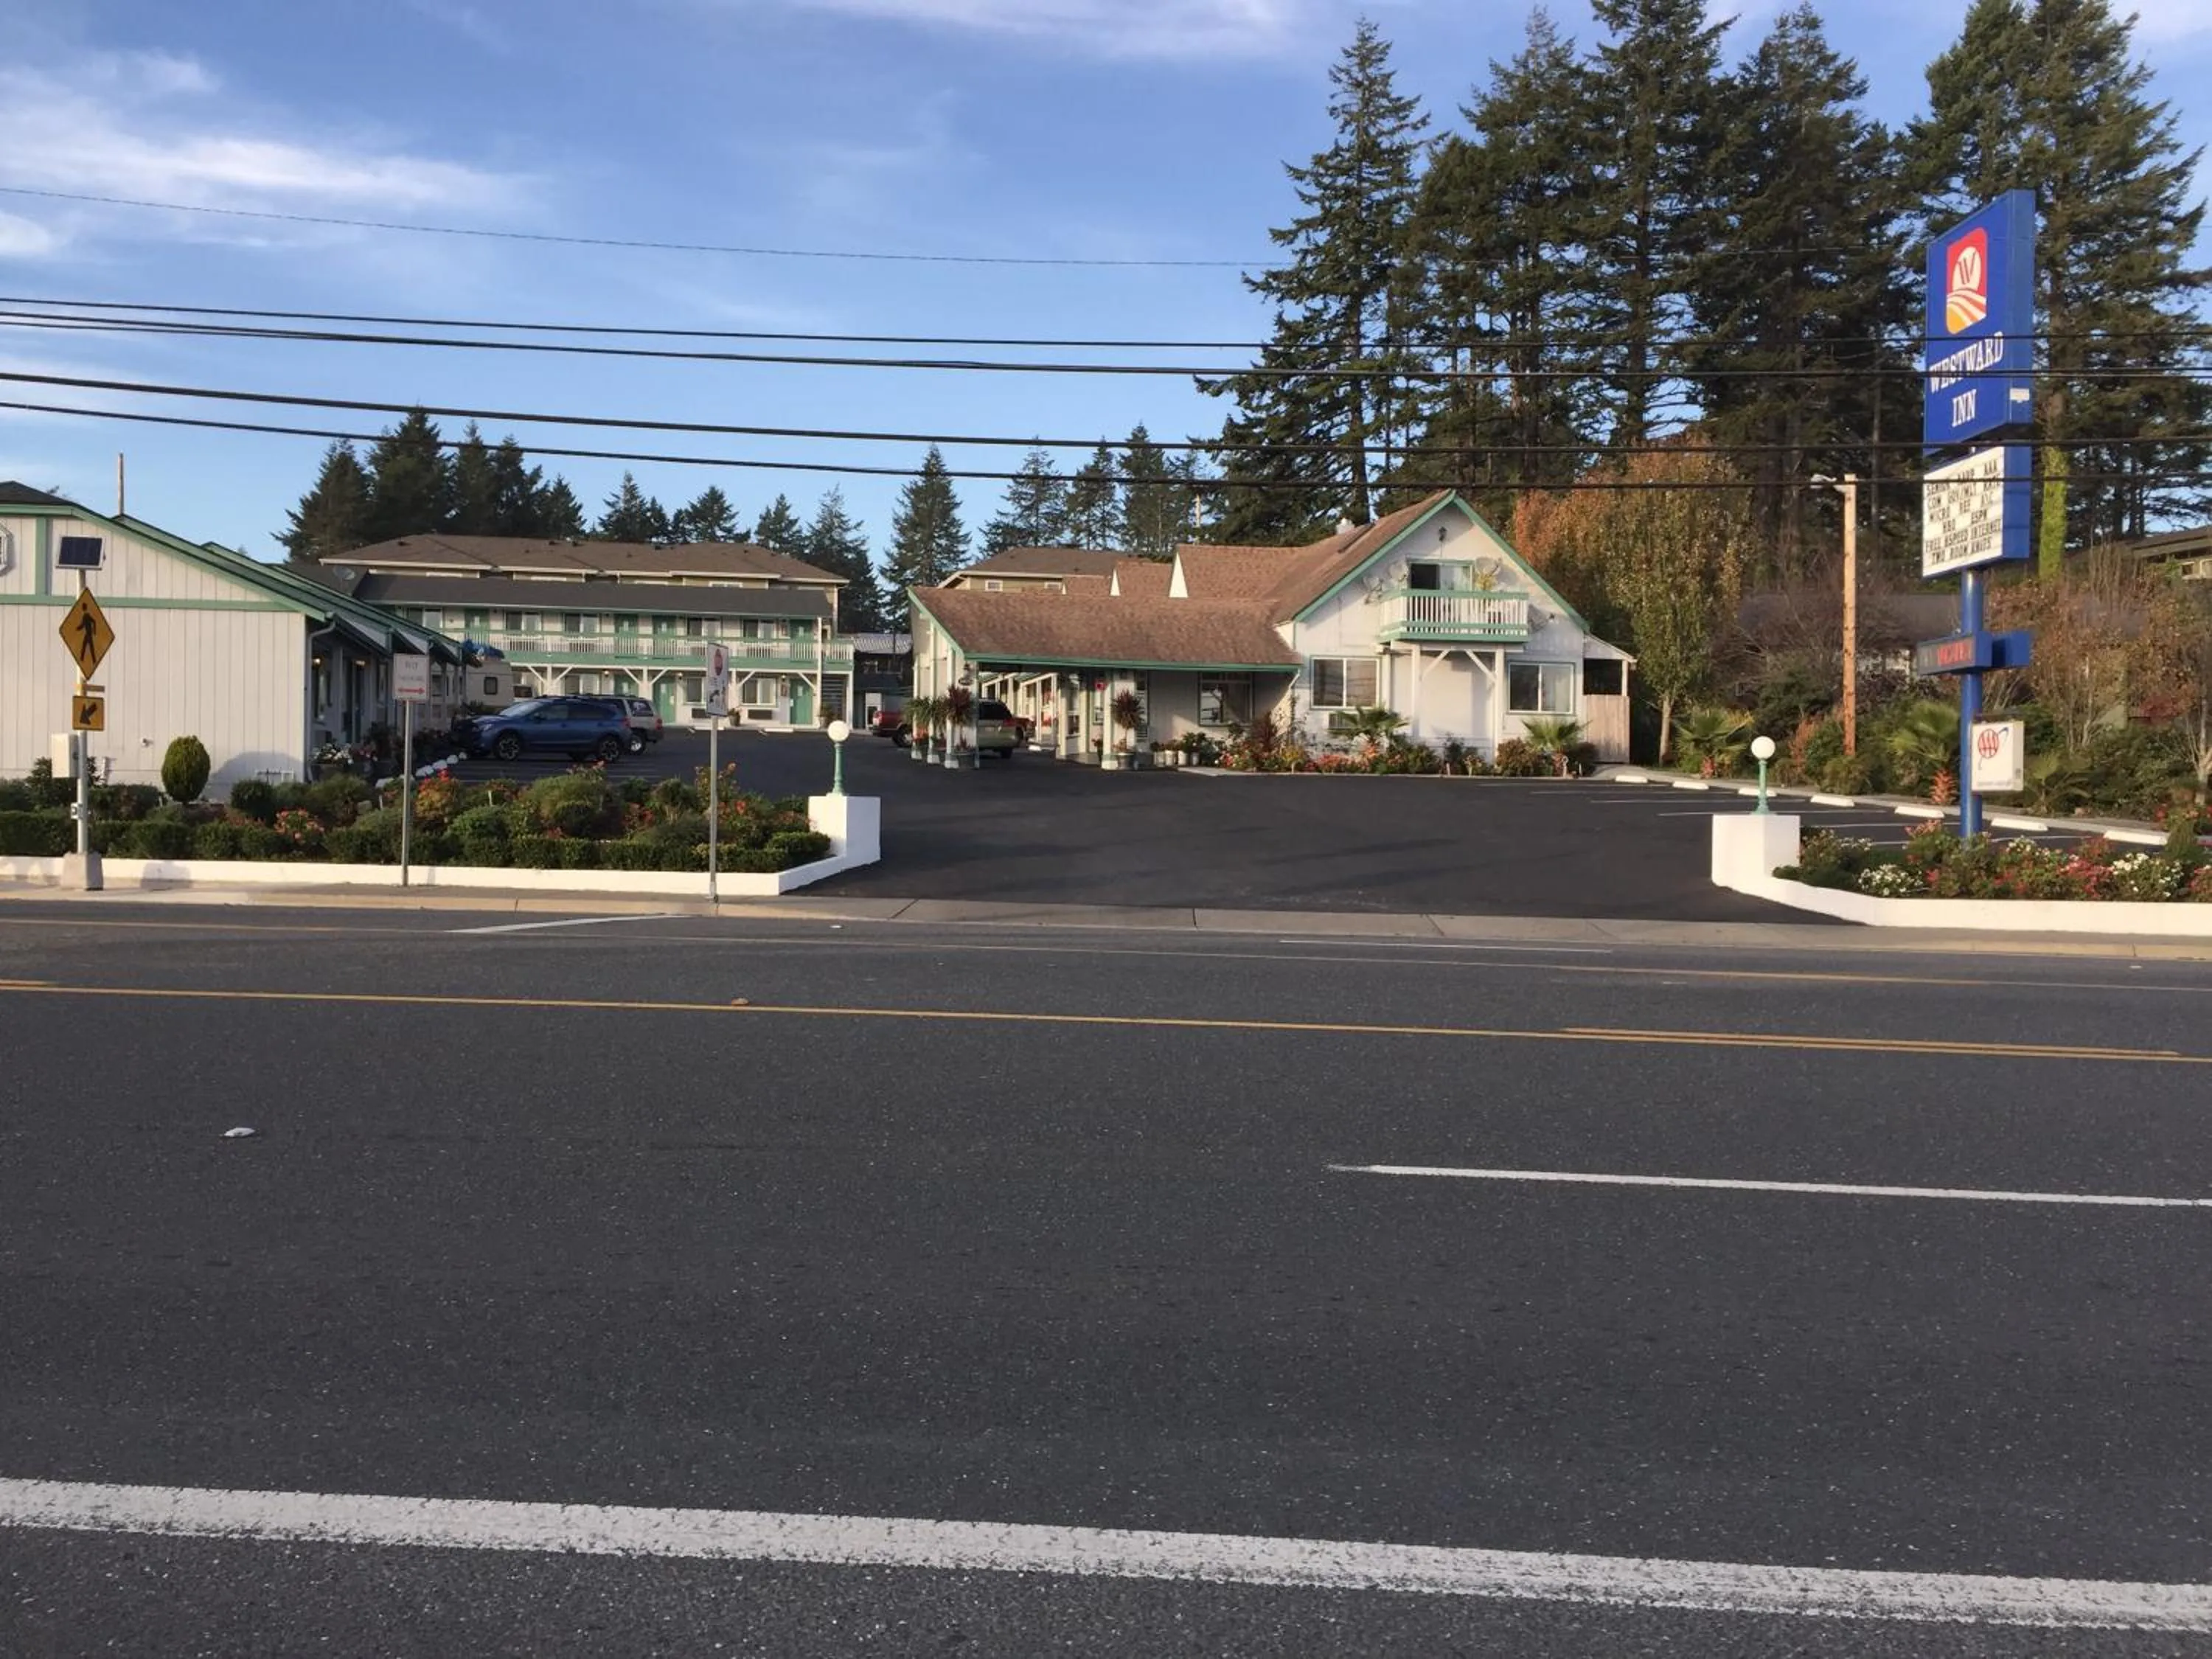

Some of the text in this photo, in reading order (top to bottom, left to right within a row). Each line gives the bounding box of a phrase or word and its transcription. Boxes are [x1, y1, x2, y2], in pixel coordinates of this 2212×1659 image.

[1929, 331, 2004, 393] WESTWARD
[1952, 389, 1977, 428] INN
[1971, 509, 1987, 524] ESPN
[1925, 537, 1941, 553] FREE
[1970, 518, 2001, 540] INTERNET
[1950, 544, 1968, 560] ROOM
